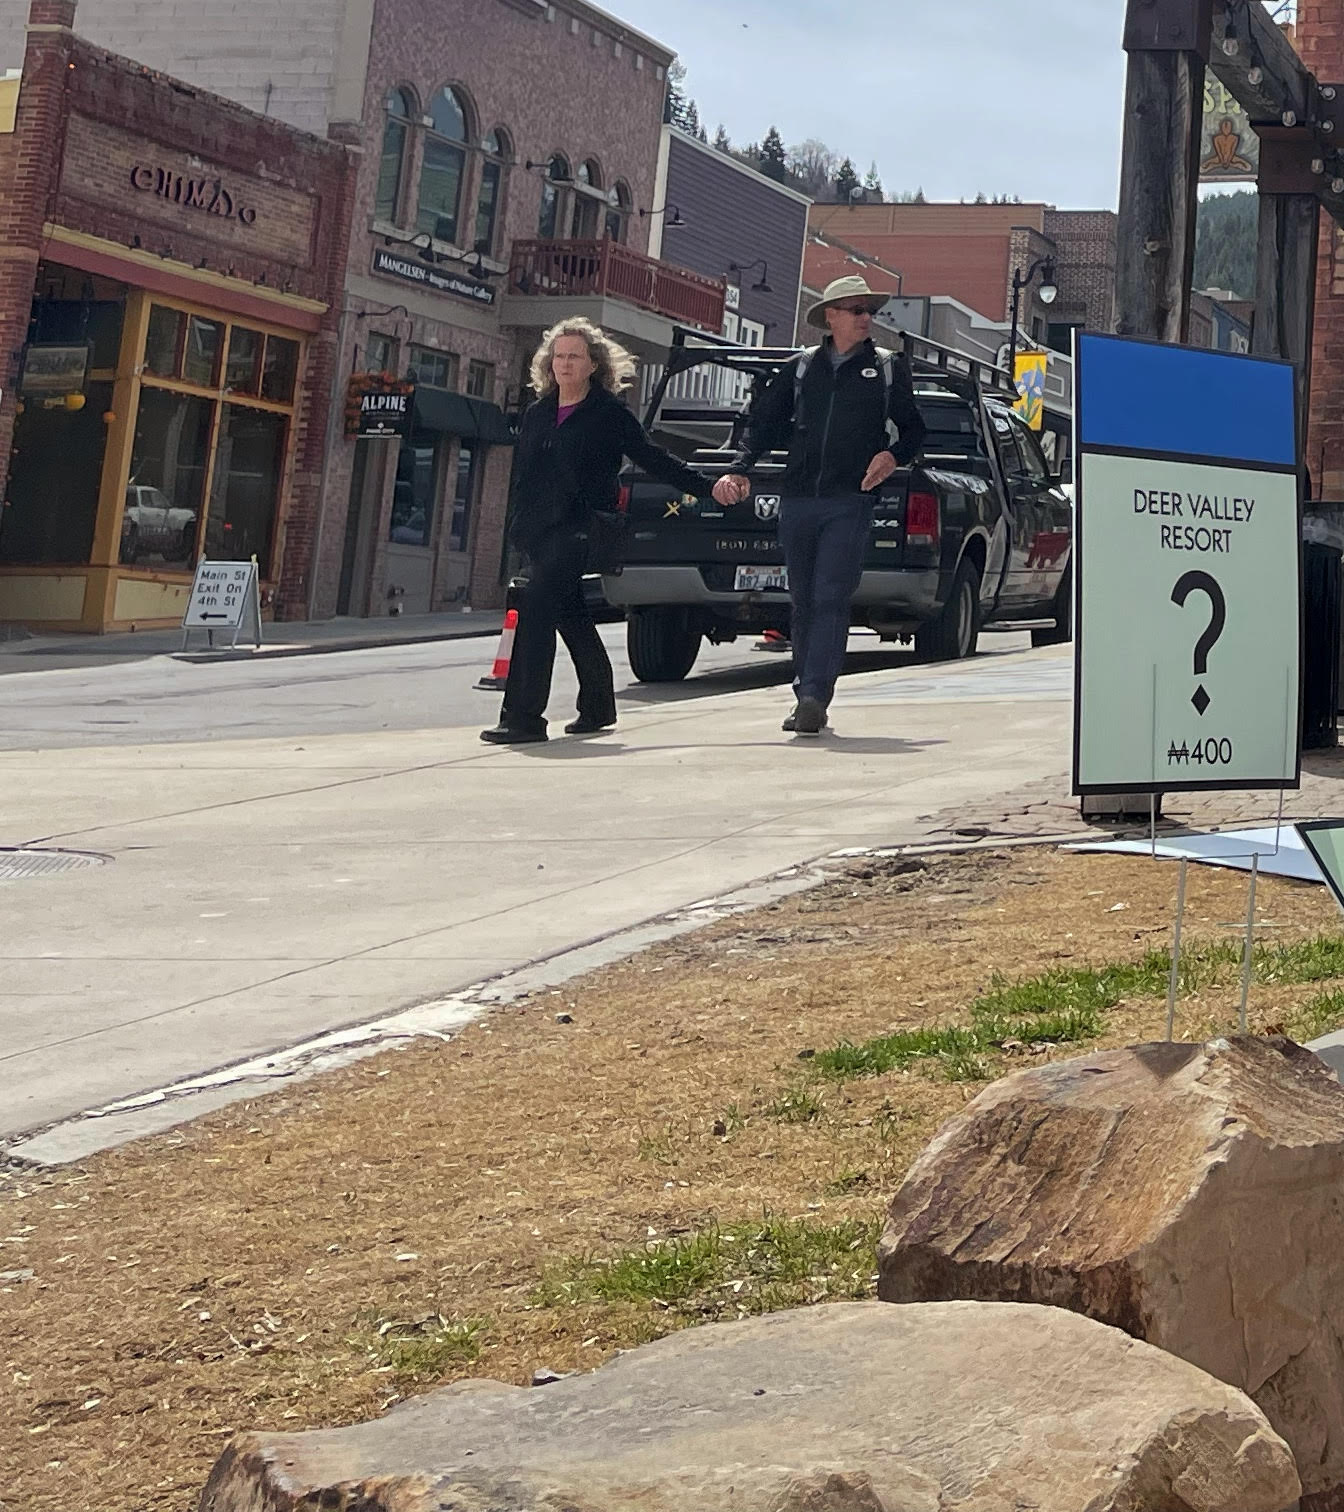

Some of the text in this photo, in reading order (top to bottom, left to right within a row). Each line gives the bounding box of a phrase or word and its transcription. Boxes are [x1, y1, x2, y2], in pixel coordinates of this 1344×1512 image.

[361, 396, 407, 412] ALPINE
[1134, 489, 1255, 522] DEER VALLEY
[1161, 525, 1232, 553] RESORT
[201, 570, 246, 581] Main St
[197, 583, 242, 594] Exit On
[198, 596, 236, 606] 4th St
